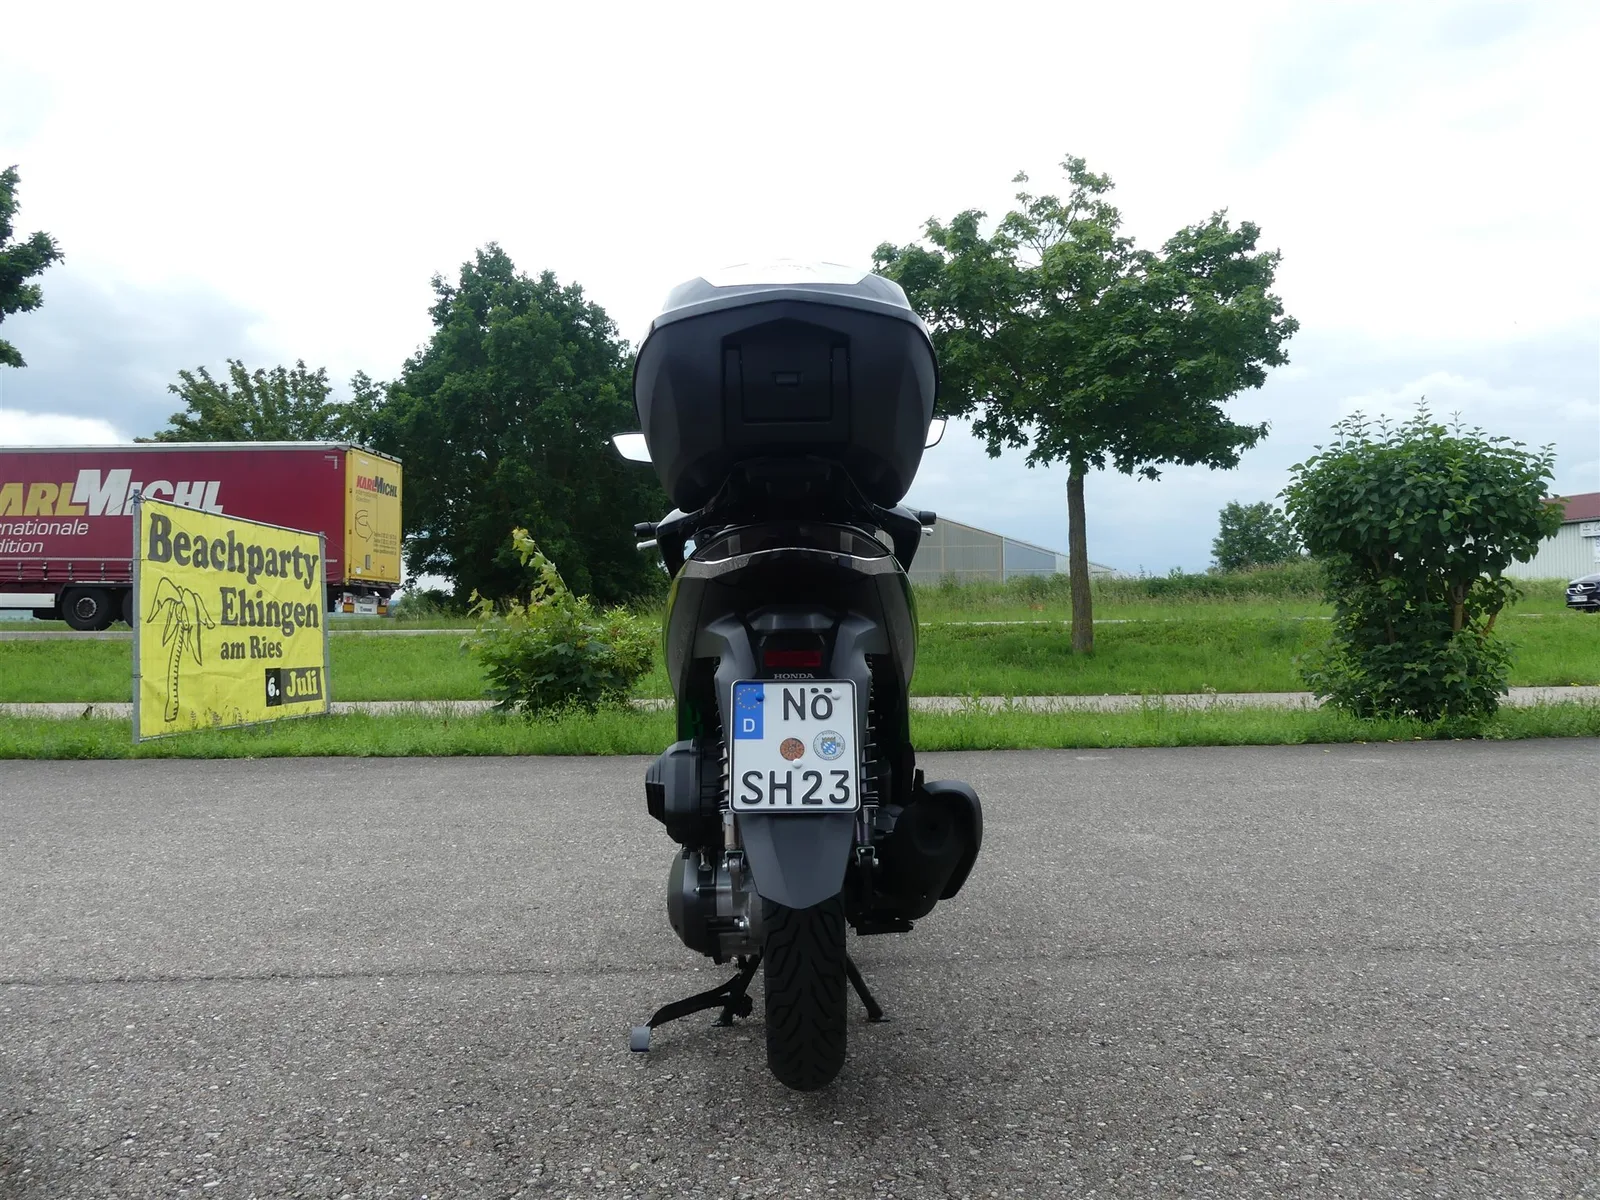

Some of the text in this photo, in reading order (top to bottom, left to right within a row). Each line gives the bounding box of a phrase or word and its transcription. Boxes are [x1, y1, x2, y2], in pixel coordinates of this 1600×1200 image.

[0, 519, 88, 535] nationale
[148, 512, 319, 589] Beachparty
[219, 586, 319, 637] Ehingen
[220, 635, 283, 660] am Ries
[267, 670, 319, 697] 6. Juli
[783, 687, 833, 721] NÖ
[743, 718, 756, 733] D
